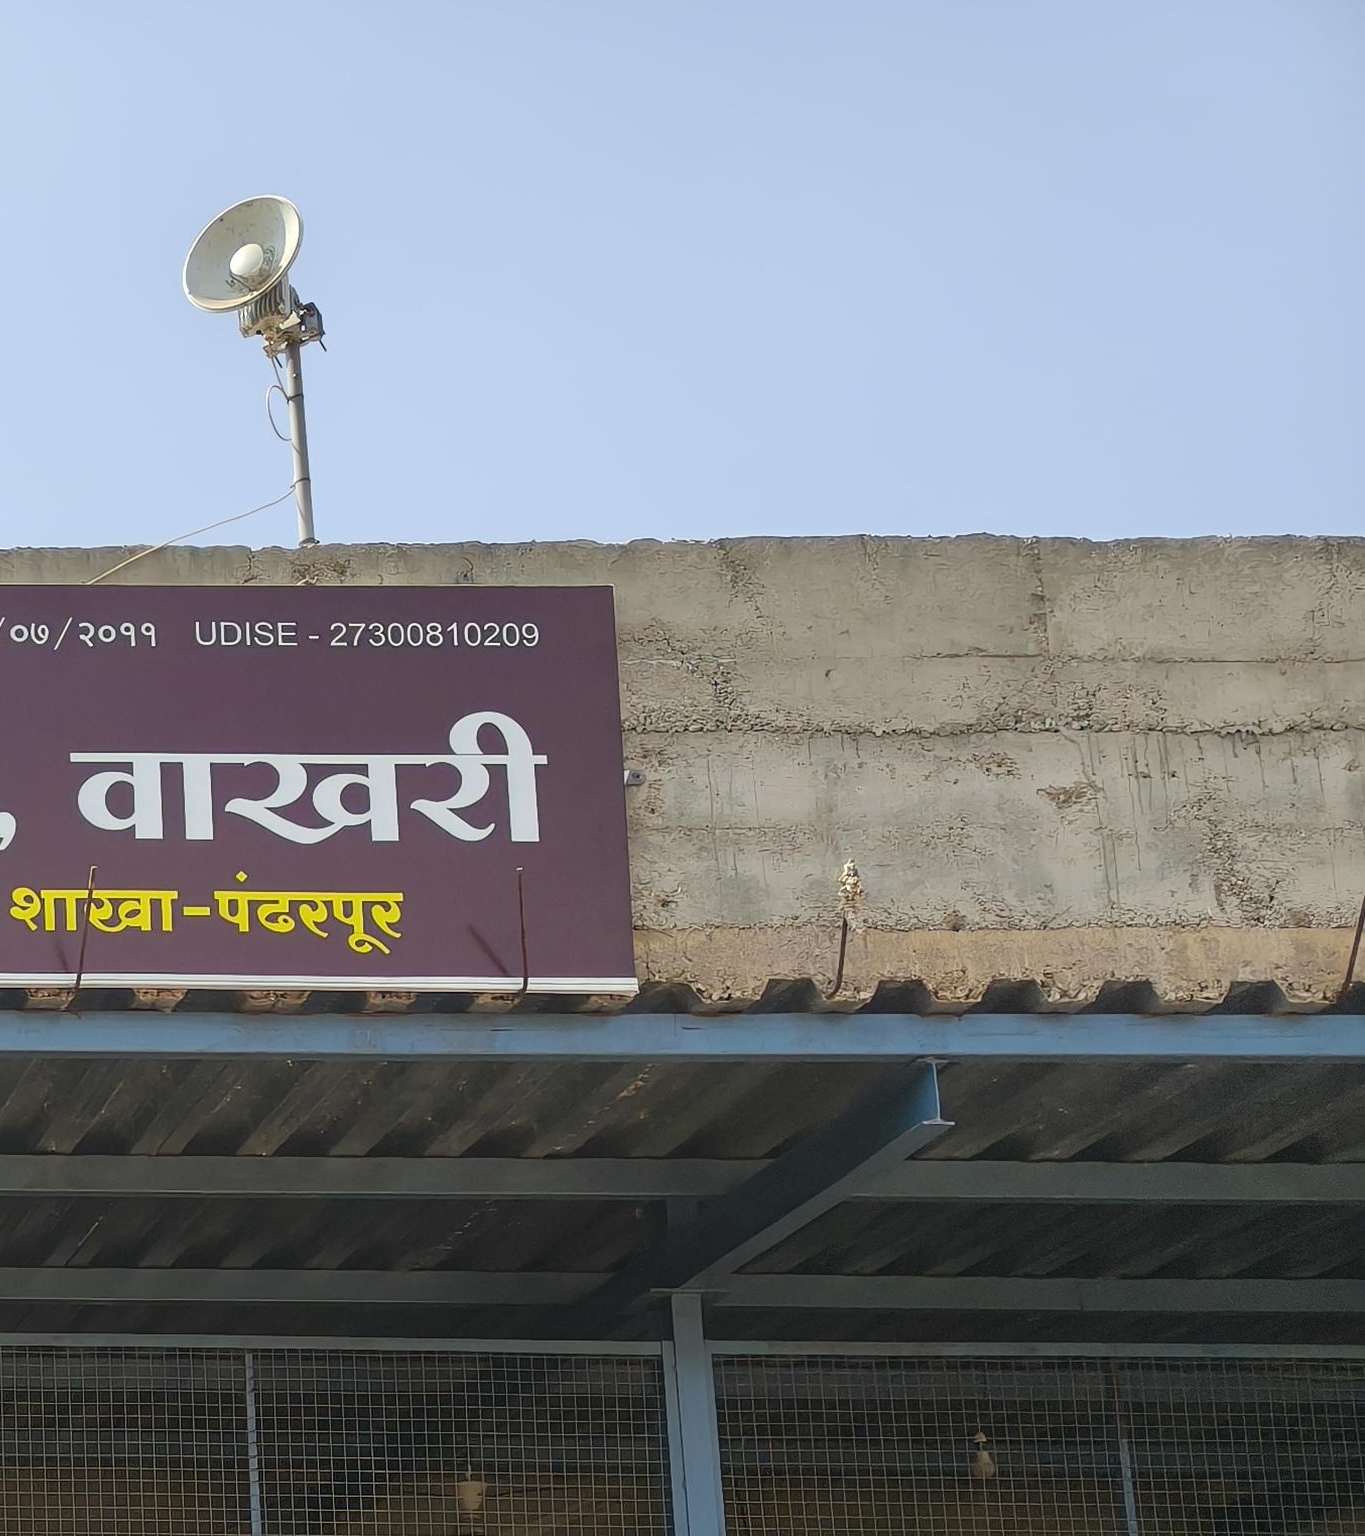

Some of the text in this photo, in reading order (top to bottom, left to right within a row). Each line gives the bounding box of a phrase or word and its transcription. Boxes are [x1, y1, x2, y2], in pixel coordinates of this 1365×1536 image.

[194, 620, 298, 647] UDISE
[329, 621, 541, 648] 27300810209
[69, 711, 547, 845] वाखरी
